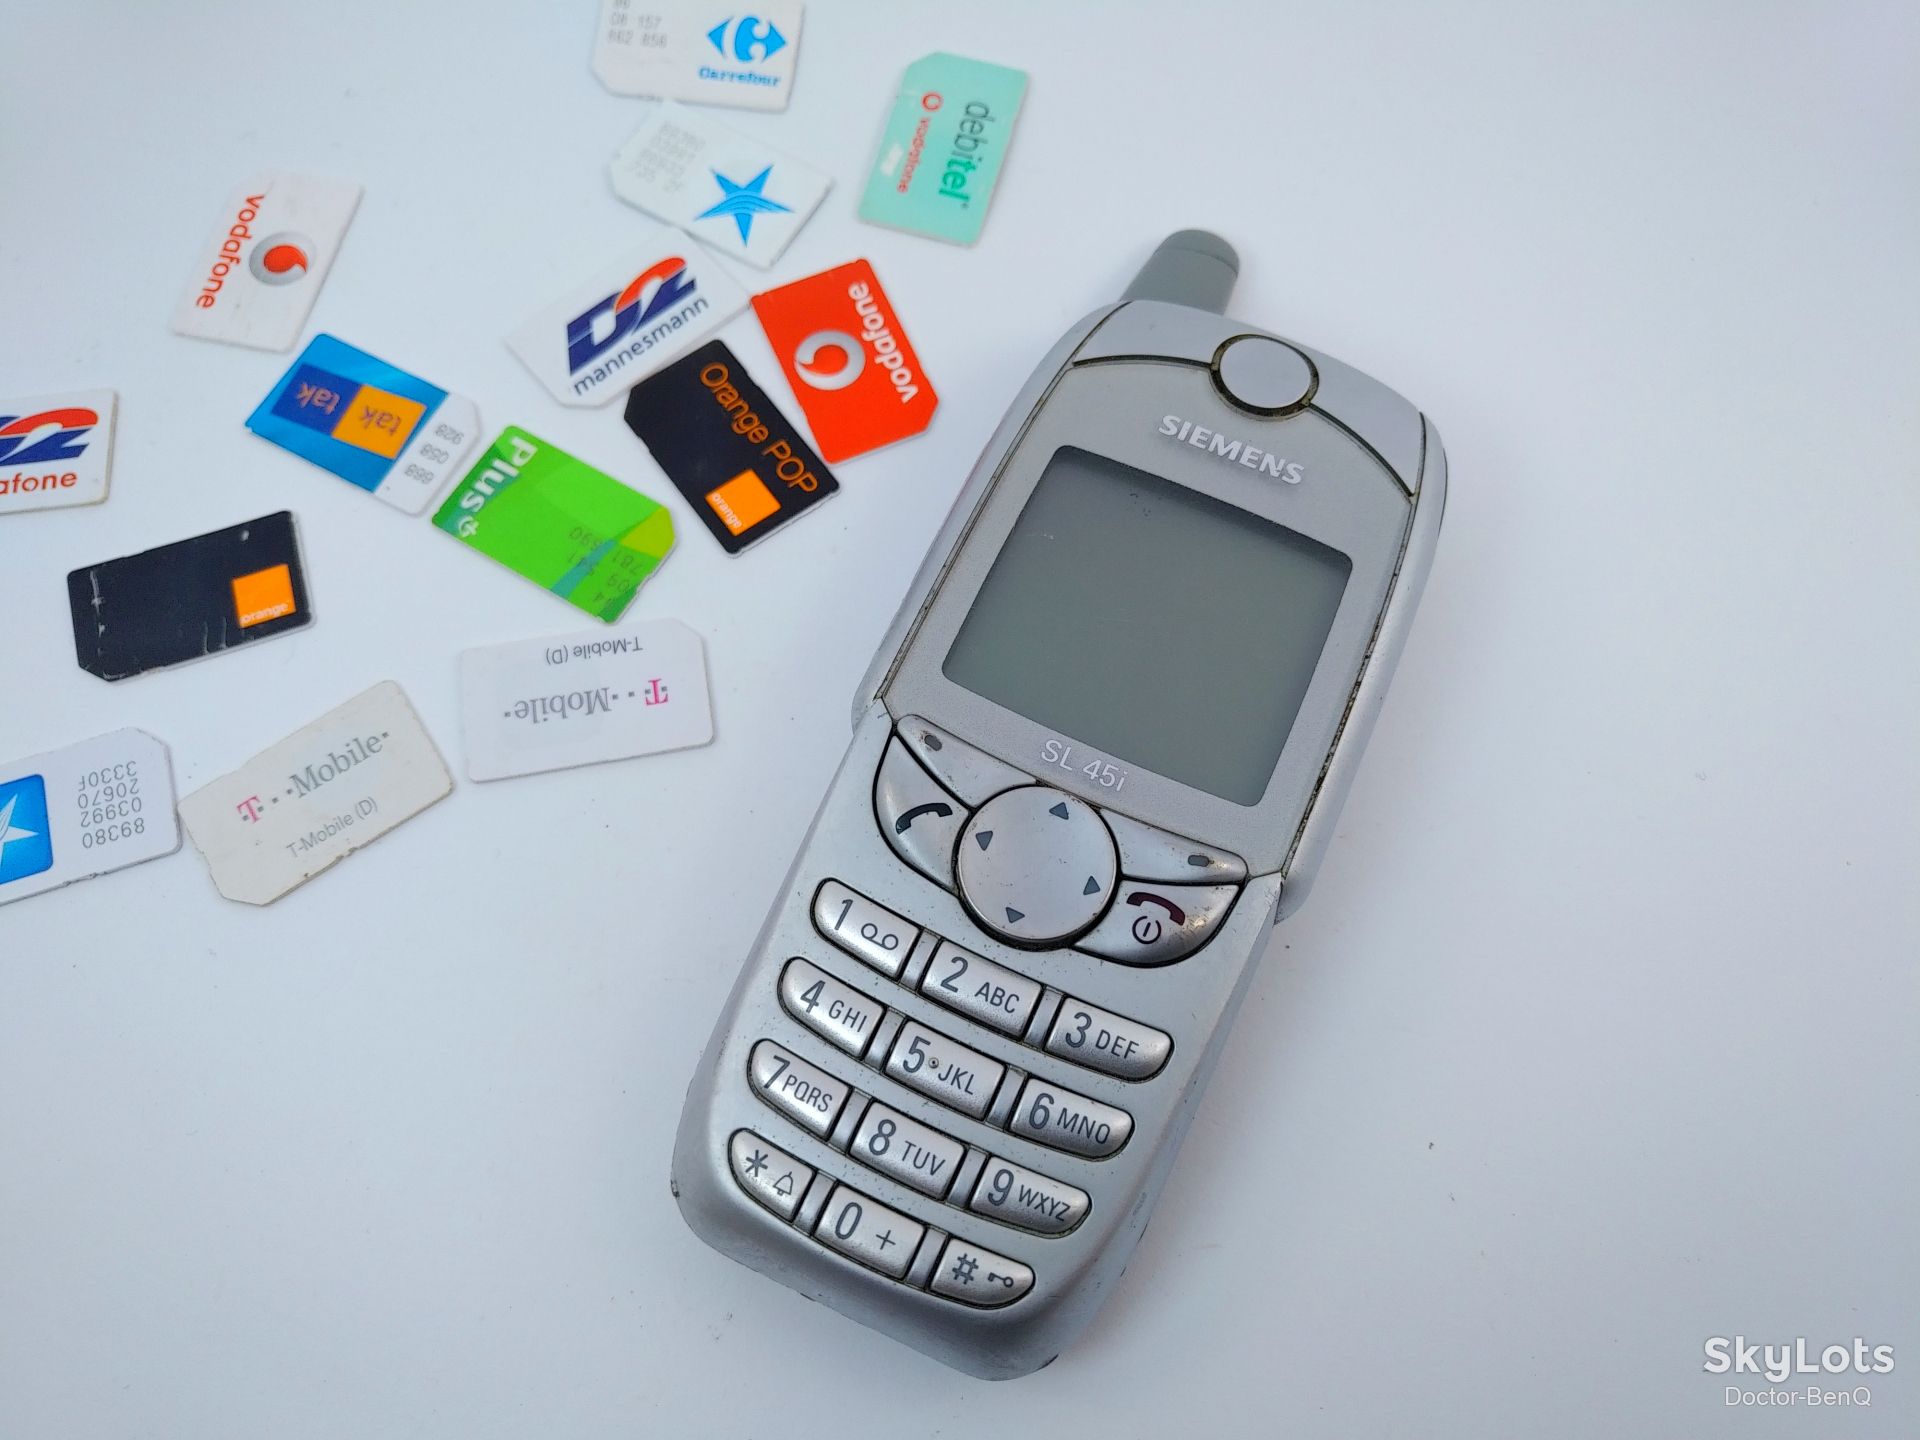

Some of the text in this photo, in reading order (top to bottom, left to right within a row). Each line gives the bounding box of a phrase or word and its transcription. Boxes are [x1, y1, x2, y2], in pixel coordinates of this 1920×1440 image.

[938, 100, 996, 204] debitel
[196, 193, 265, 309] vodafone
[573, 296, 709, 396] mannesmann
[848, 280, 918, 404] vodafone
[296, 382, 341, 415] tak
[360, 405, 403, 437] tak
[701, 362, 818, 494] Orange POP
[1158, 414, 1305, 485] SIEMENS
[459, 436, 538, 514] Plus
[712, 492, 742, 528] orange
[240, 603, 289, 624] orange
[546, 635, 643, 666] T-Mobile (D)
[78, 760, 137, 792] 3330F
[1040, 738, 1129, 793] SL 45i
[78, 778, 140, 810] 20670
[80, 798, 142, 829] 03992
[82, 818, 145, 850] 89380
[286, 795, 379, 859] T-Mobile (D)
[833, 898, 854, 932] 1
[800, 980, 868, 1034] 4 GHI
[940, 956, 1020, 1015] 2 ABC
[1065, 1012, 1139, 1061] 3 DEF
[763, 1055, 833, 1113] 7 PQRS
[902, 1035, 976, 1097] 5 JKL
[1029, 1092, 1112, 1145] 6 MNO
[868, 1119, 947, 1176] 8 TUV
[835, 1202, 863, 1240] 0
[987, 1168, 1072, 1223] 9 WXYZ
